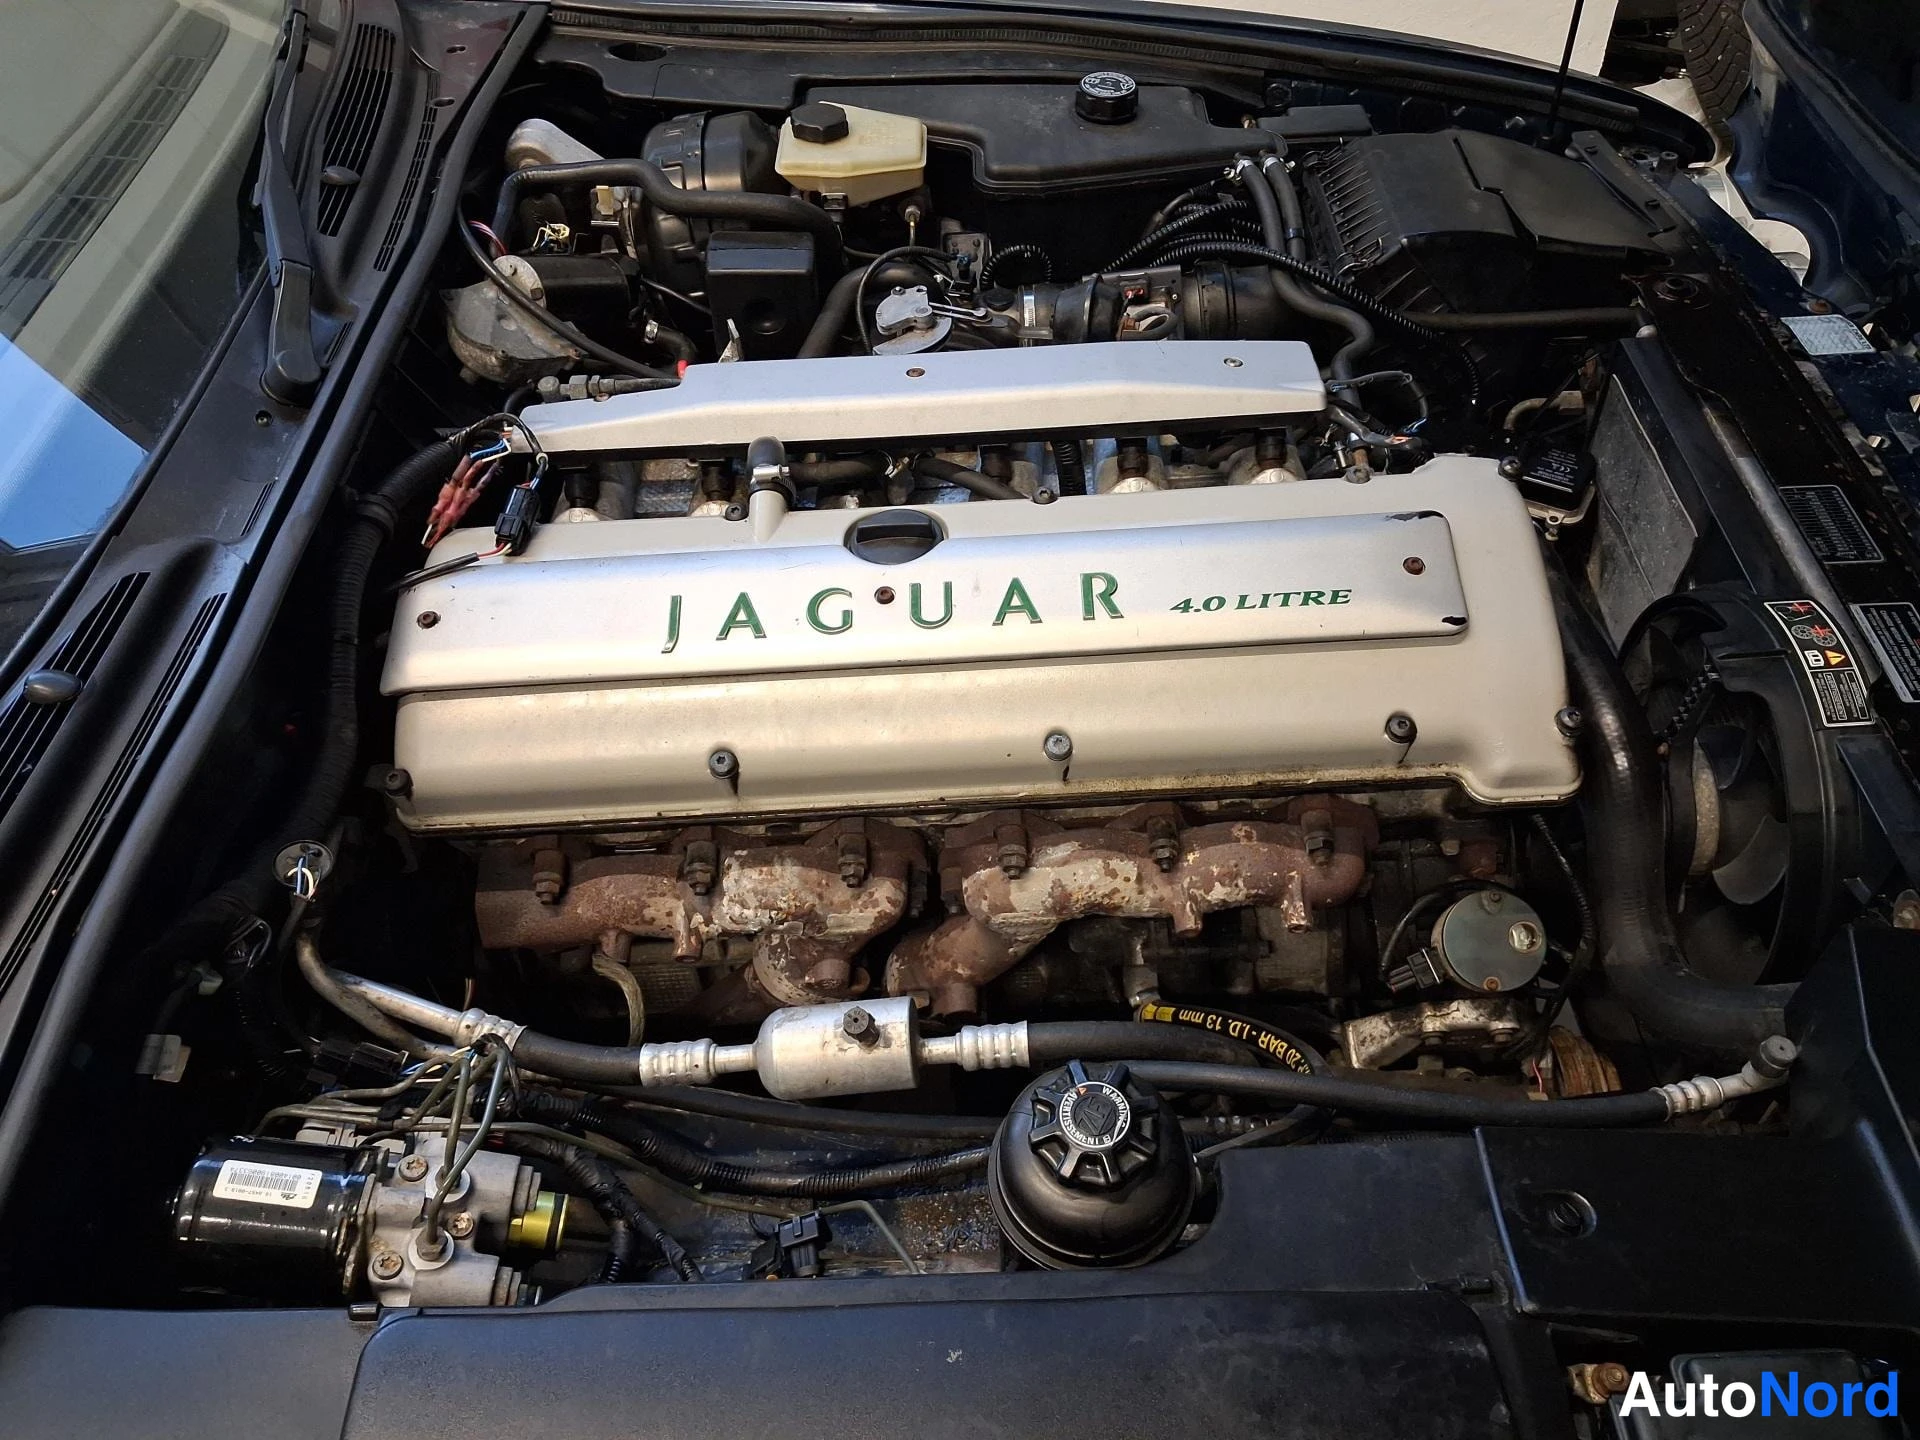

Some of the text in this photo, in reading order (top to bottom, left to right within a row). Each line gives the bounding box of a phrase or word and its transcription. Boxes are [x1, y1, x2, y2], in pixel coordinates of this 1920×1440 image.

[661, 572, 1352, 654] JAGUAR 4.0 LITRE
[1179, 1009, 1205, 1023] mm
[1206, 1014, 1222, 1031] 13
[1228, 1019, 1251, 1040] I.D.
[1258, 1030, 1290, 1060] BAR
[1286, 1048, 1302, 1069] 20
[1062, 1092, 1100, 1145] AVERTISSEMENT
